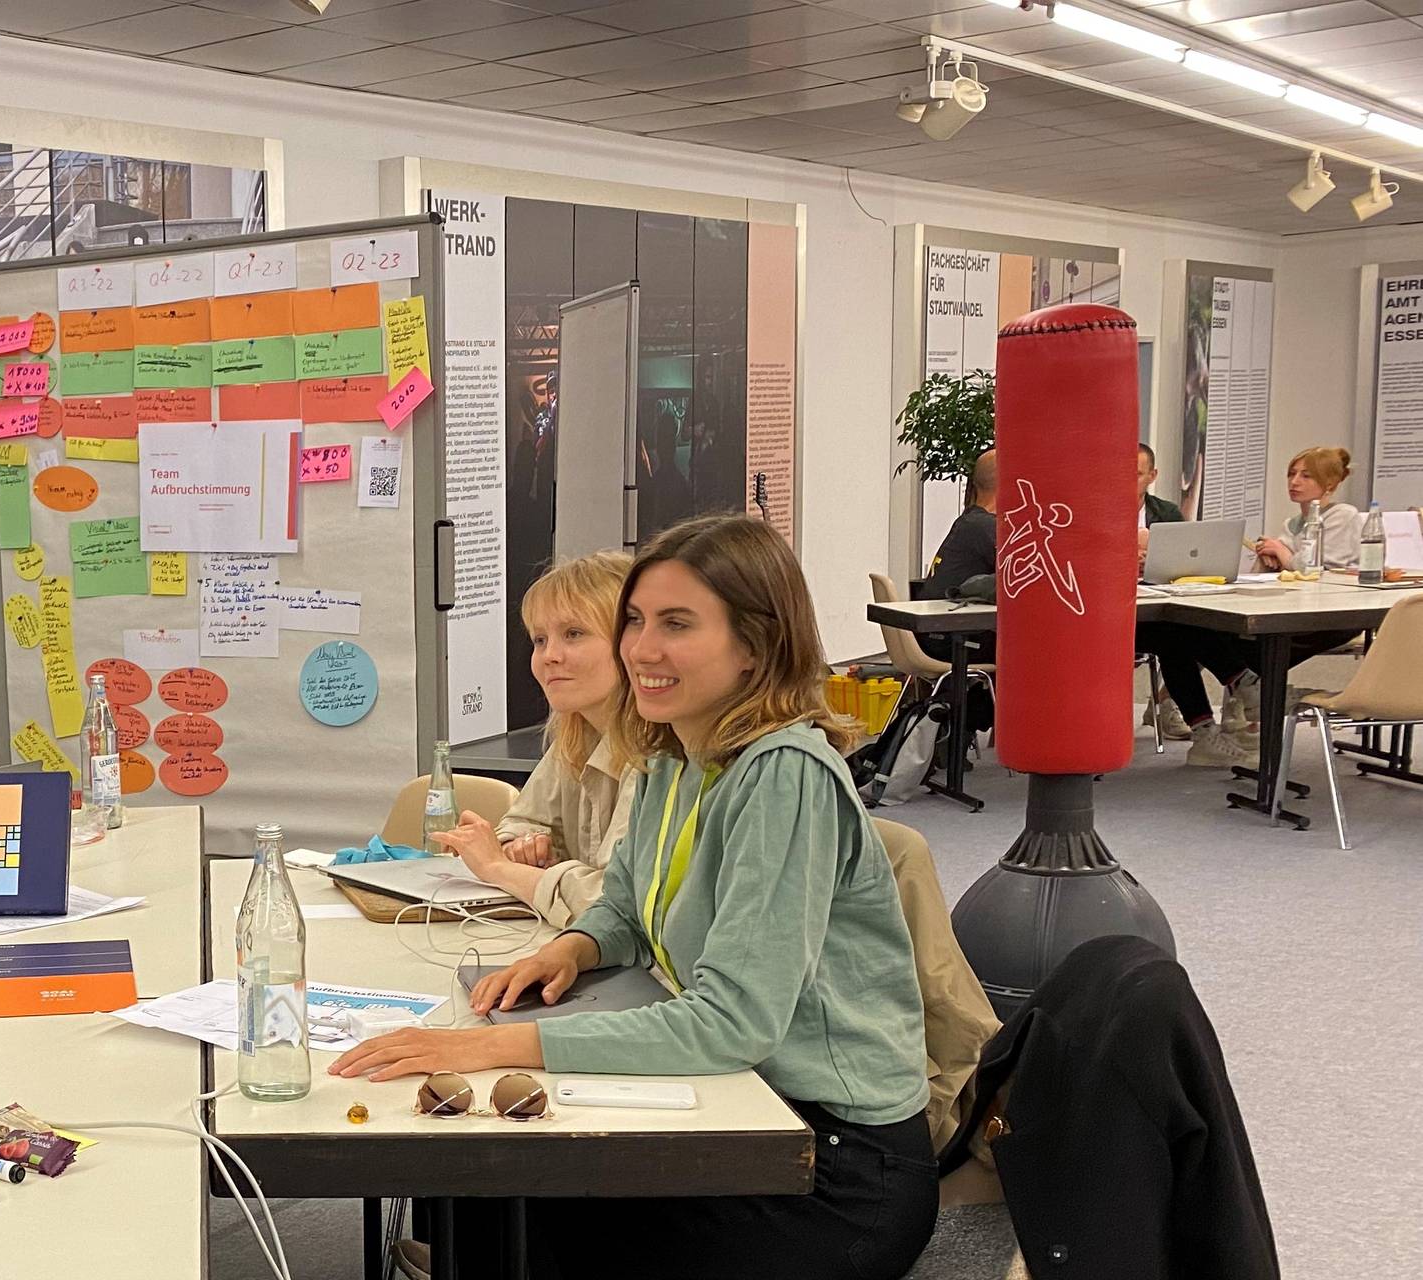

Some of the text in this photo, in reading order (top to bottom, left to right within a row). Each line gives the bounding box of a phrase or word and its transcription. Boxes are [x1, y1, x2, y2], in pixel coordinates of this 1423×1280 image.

[435, 199, 486, 223] WERK-
[445, 233, 496, 256] TRAND
[228, 261, 284, 280] Q1-23
[342, 252, 401, 271] Q2-23
[930, 253, 990, 272] FACHGESCHÄFT
[69, 277, 113, 292] Q3-22
[149, 269, 203, 287] Q4-22
[930, 273, 945, 291] FÜR
[929, 300, 983, 317] STADTWANDEL
[1385, 296, 1420, 308] AMT
[151, 469, 179, 479] Team
[151, 484, 251, 496] Aufbruchstimmung
[462, 701, 483, 716] STRAND
